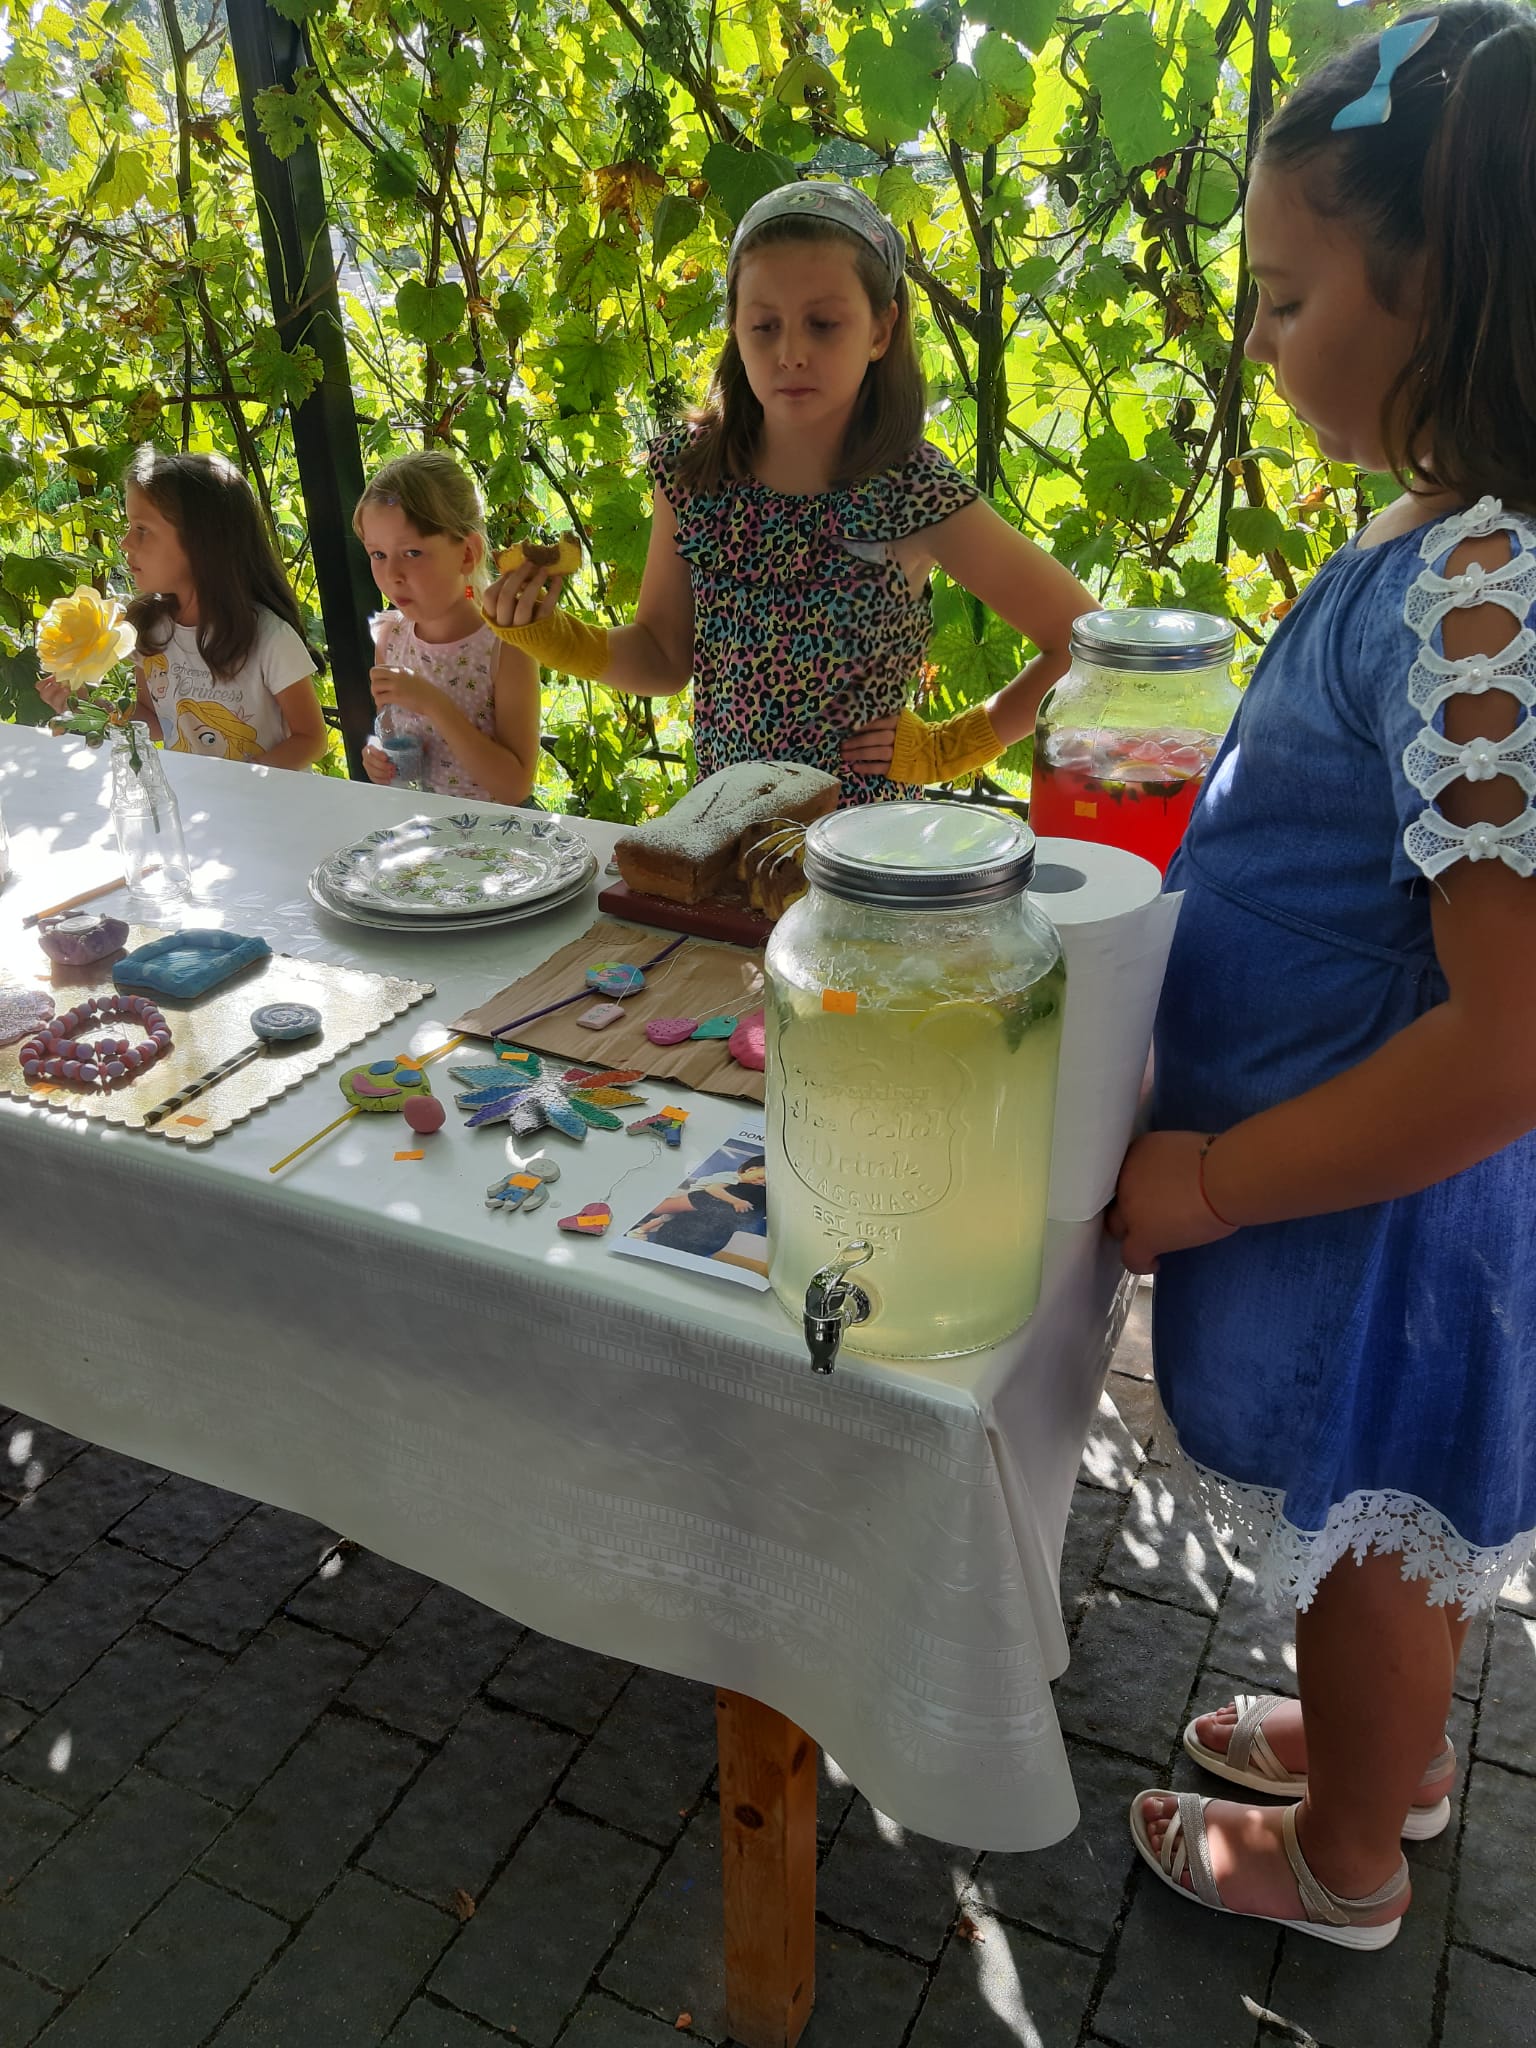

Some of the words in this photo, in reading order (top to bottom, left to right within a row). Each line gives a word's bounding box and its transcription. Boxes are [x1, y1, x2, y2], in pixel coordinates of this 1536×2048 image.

[173, 673, 244, 703] Princess
[738, 1130, 766, 1143] DON
[850, 1105, 945, 1143] Cold
[800, 1135, 921, 1180] Drink
[791, 1153, 938, 1212] GLASSWARE
